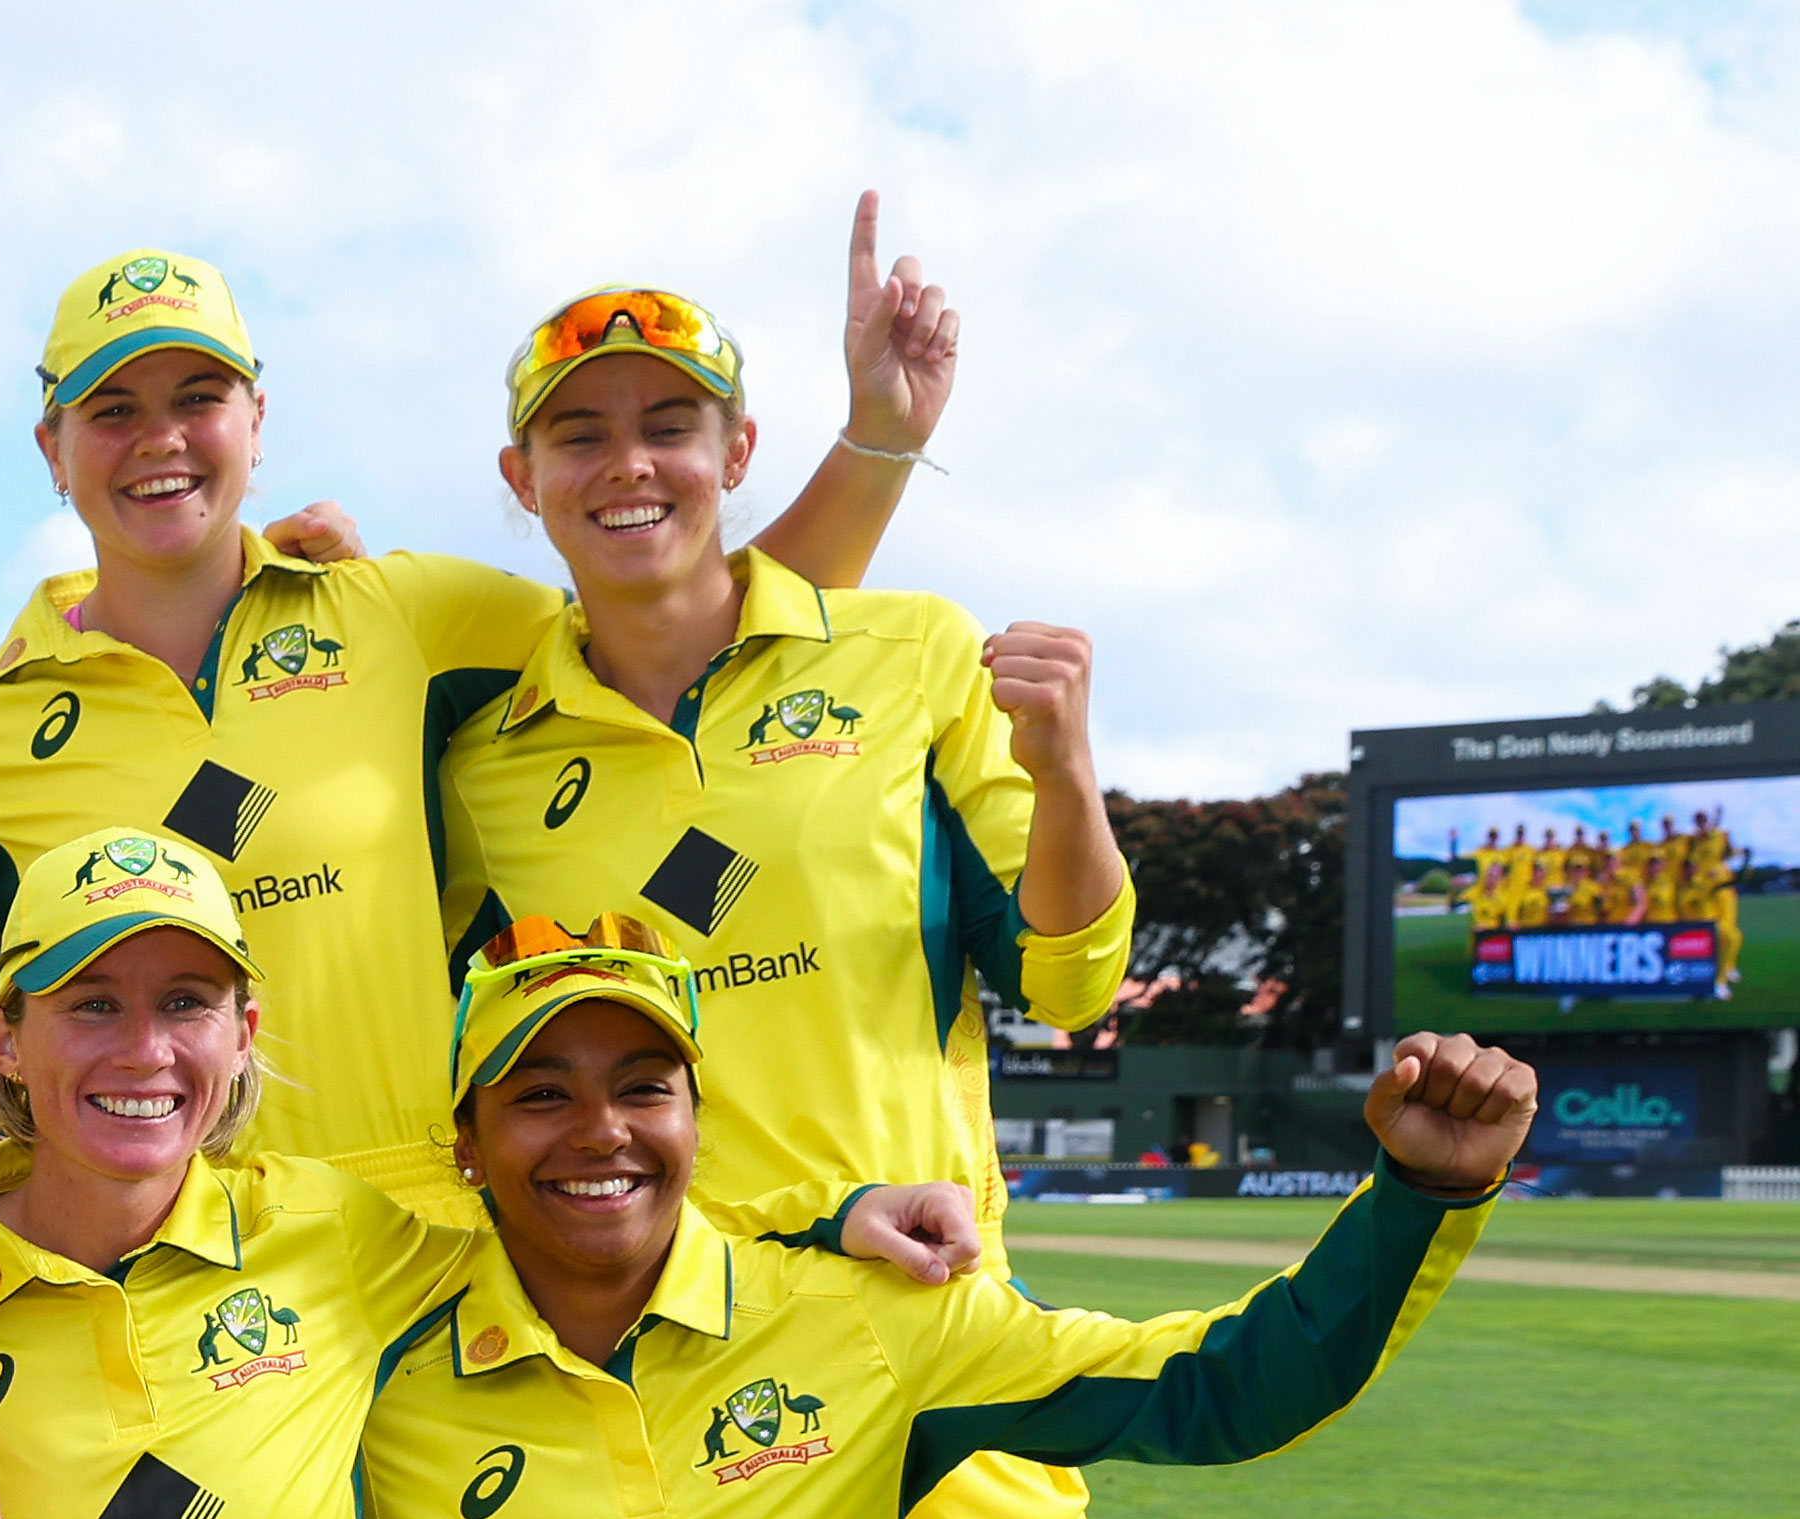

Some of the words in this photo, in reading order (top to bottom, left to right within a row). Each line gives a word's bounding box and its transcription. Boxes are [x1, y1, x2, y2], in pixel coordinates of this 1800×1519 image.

[1453, 738, 1493, 761] The
[1498, 736, 1545, 760] Don
[1616, 719, 1754, 752] Scoreboard
[110, 879, 171, 899] AUSTRALIA
[231, 864, 344, 914] mBank
[1513, 930, 1665, 984] WINNERS
[1237, 1171, 1369, 1196] AUSTRAL
[239, 1360, 288, 1380] AUSTRALIA
[745, 1448, 805, 1471] AUSTRALIA
